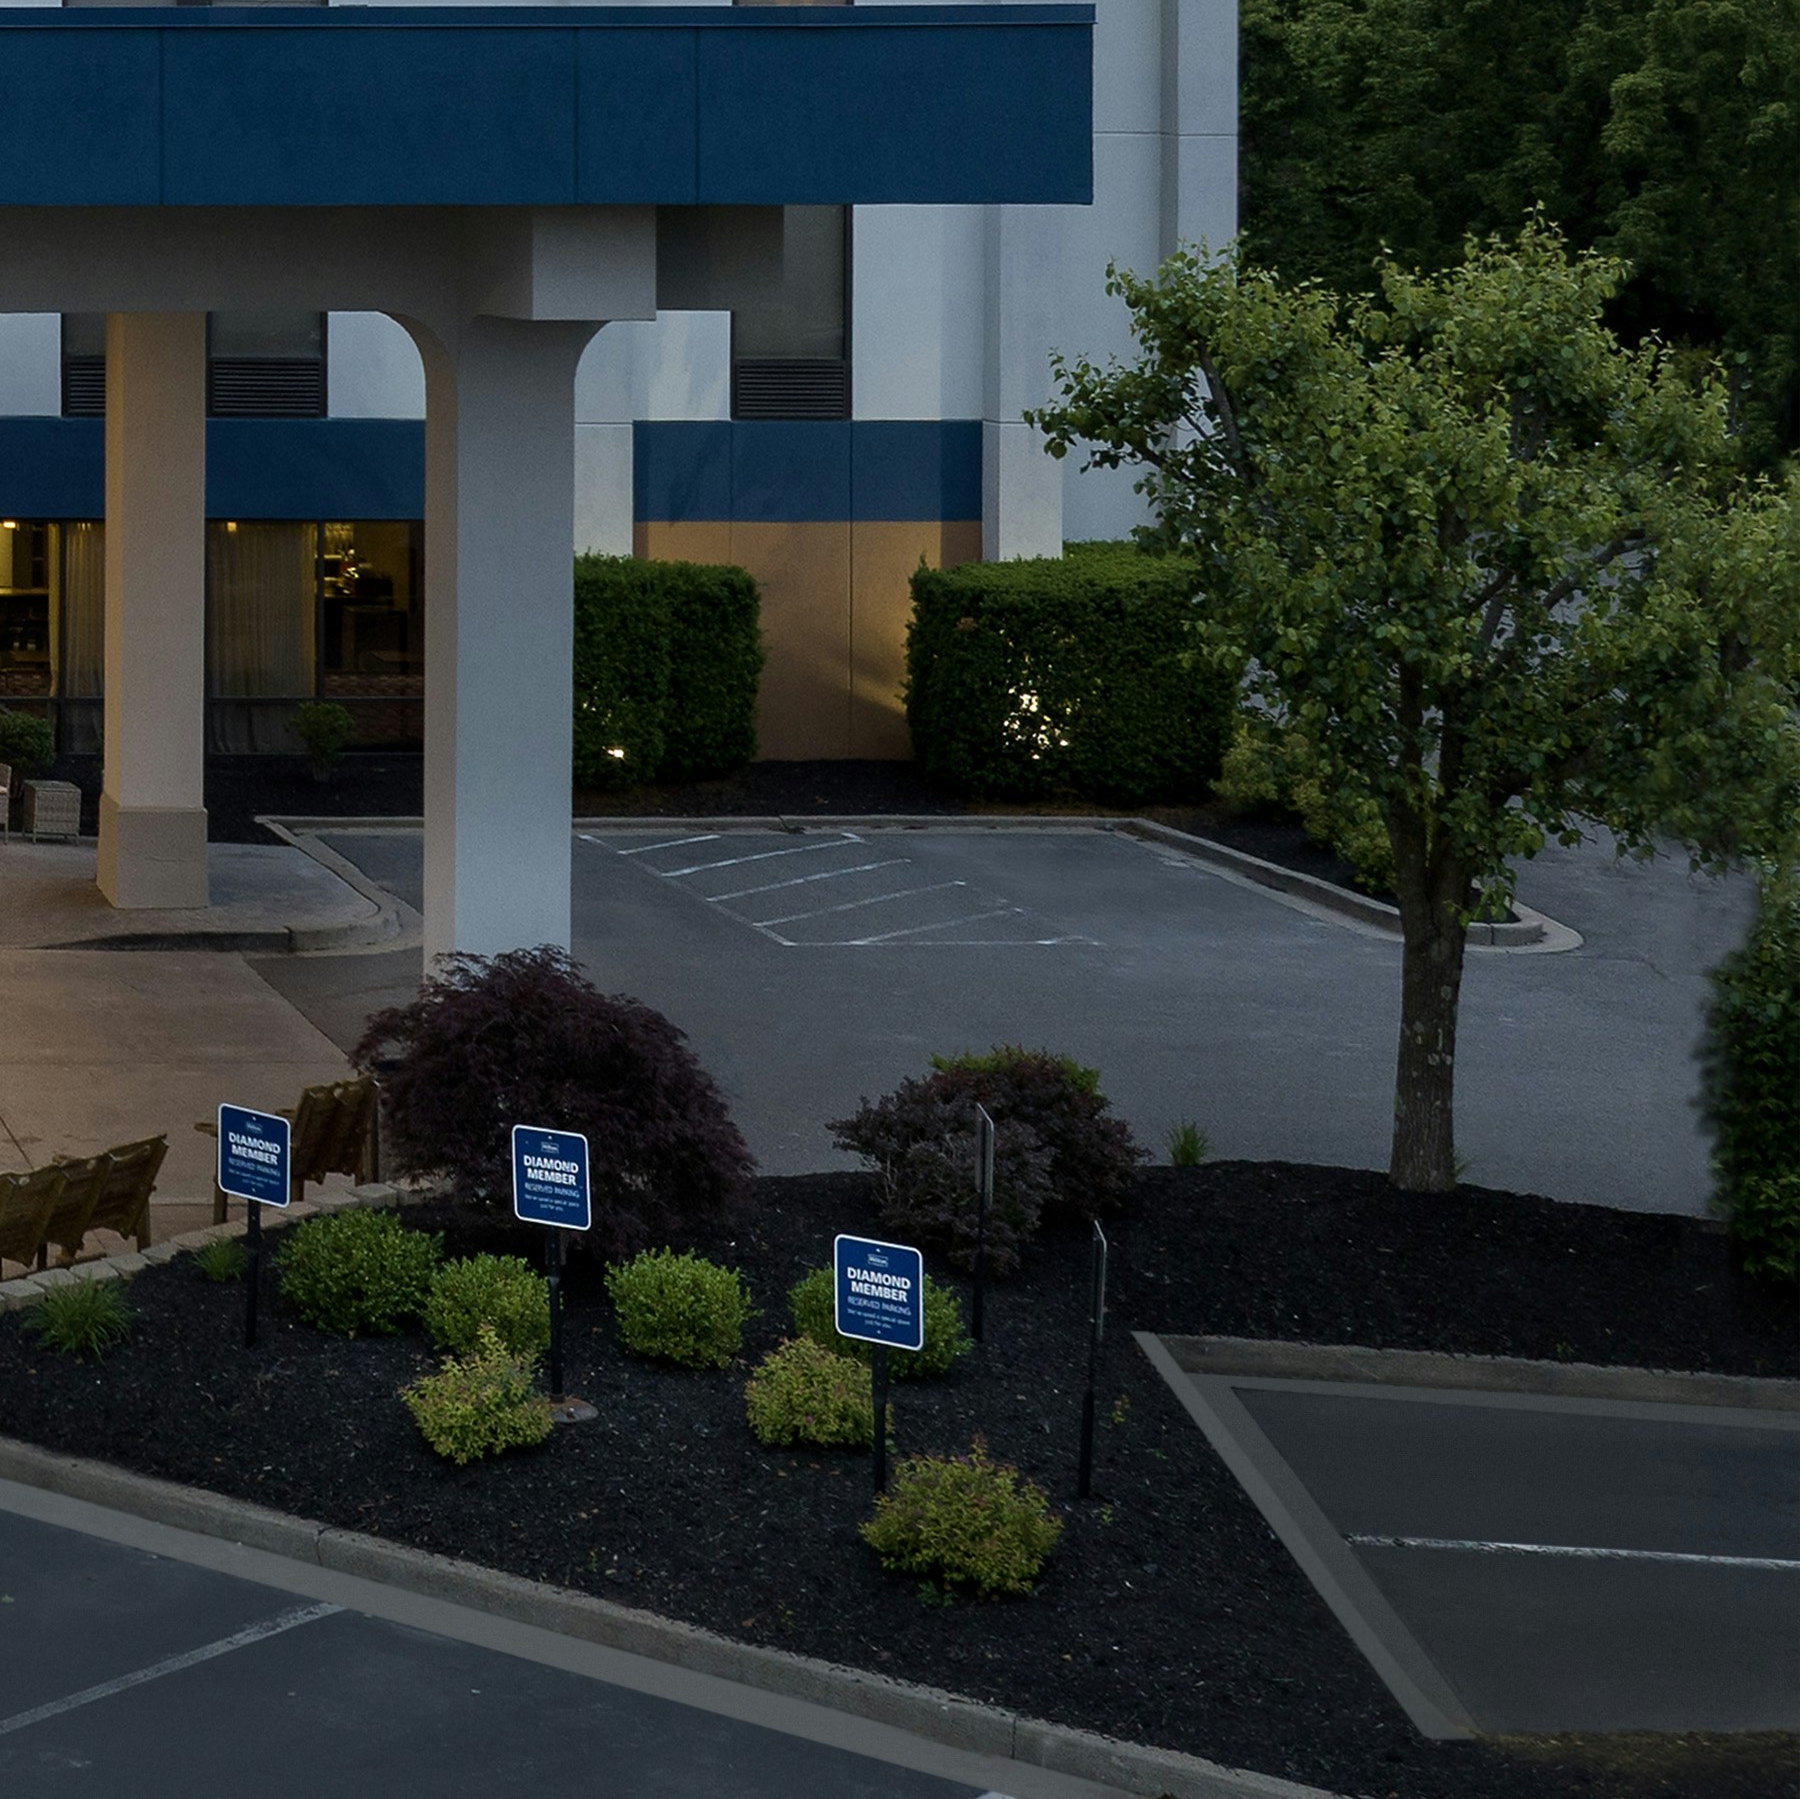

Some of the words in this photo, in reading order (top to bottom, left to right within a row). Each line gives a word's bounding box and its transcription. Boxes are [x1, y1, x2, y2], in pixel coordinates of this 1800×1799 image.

[228, 1131, 281, 1154] DIAMOND
[231, 1144, 278, 1166] MEMBER
[523, 1154, 579, 1174] DIAMOND
[527, 1167, 577, 1186] MEMBER
[847, 1266, 911, 1290] DIAMOND
[851, 1281, 908, 1303] MEMBER
